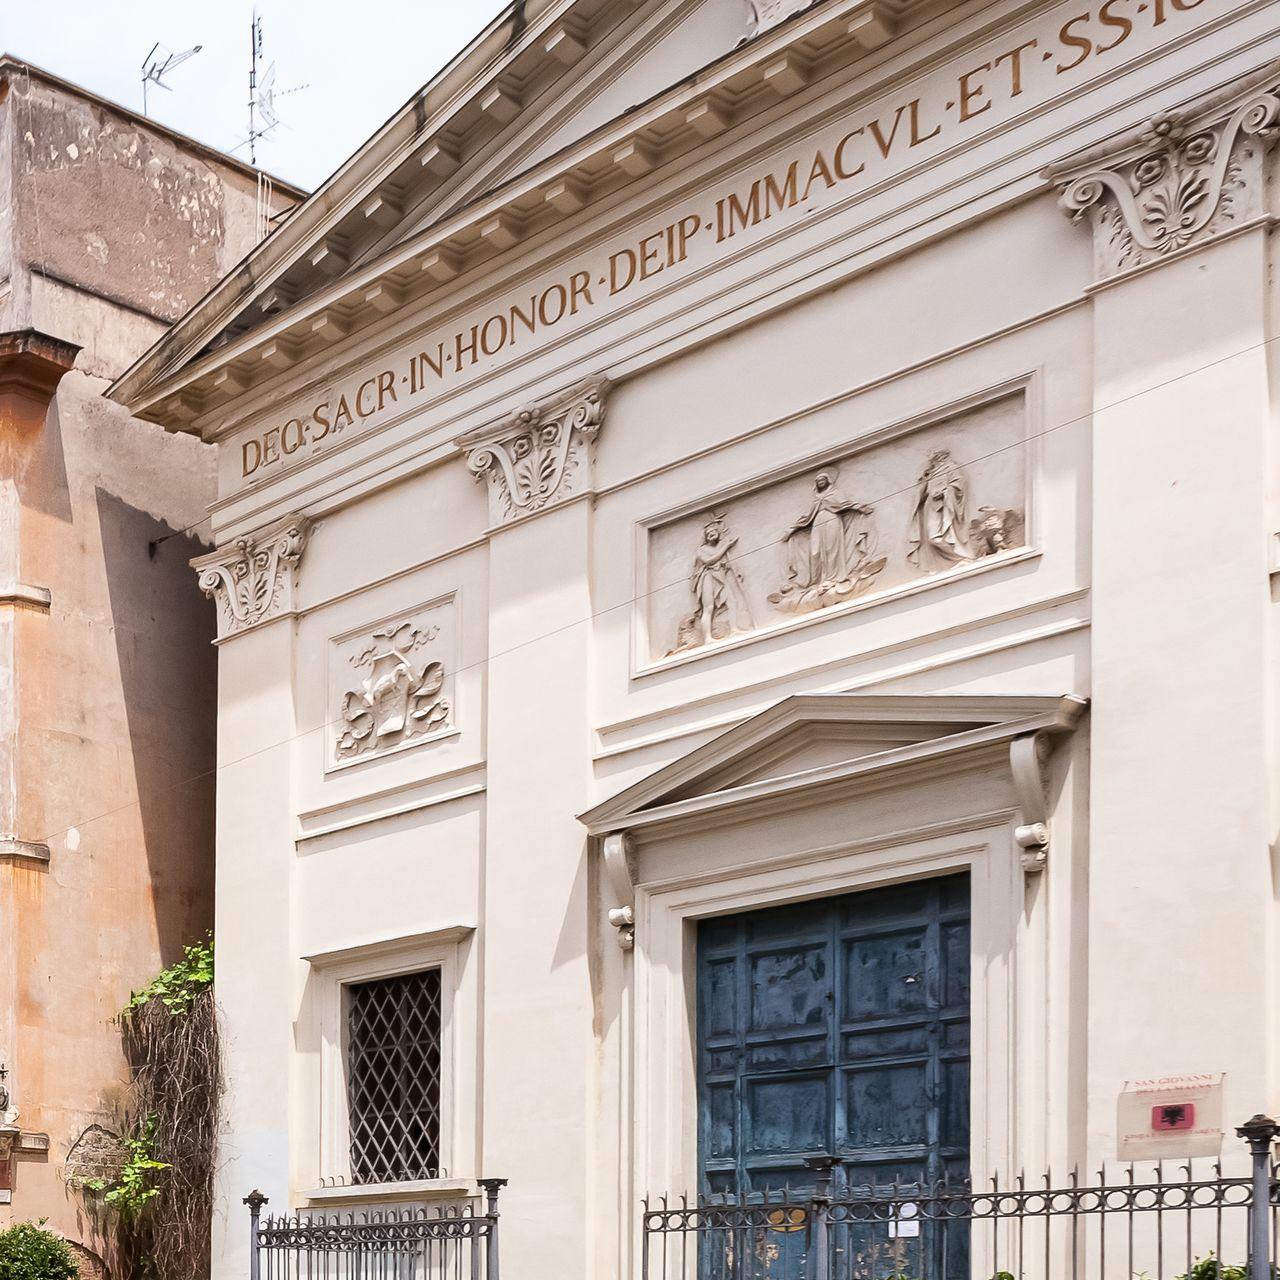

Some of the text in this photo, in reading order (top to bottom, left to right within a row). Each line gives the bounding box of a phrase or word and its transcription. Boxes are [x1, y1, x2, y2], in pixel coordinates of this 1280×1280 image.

[241, 418, 304, 477] DEO
[312, 370, 398, 443] SACR
[408, 343, 444, 394] IN
[454, 270, 594, 372] HONOR
[714, 98, 942, 243] IMMACVL
[958, 38, 1037, 123] ET
